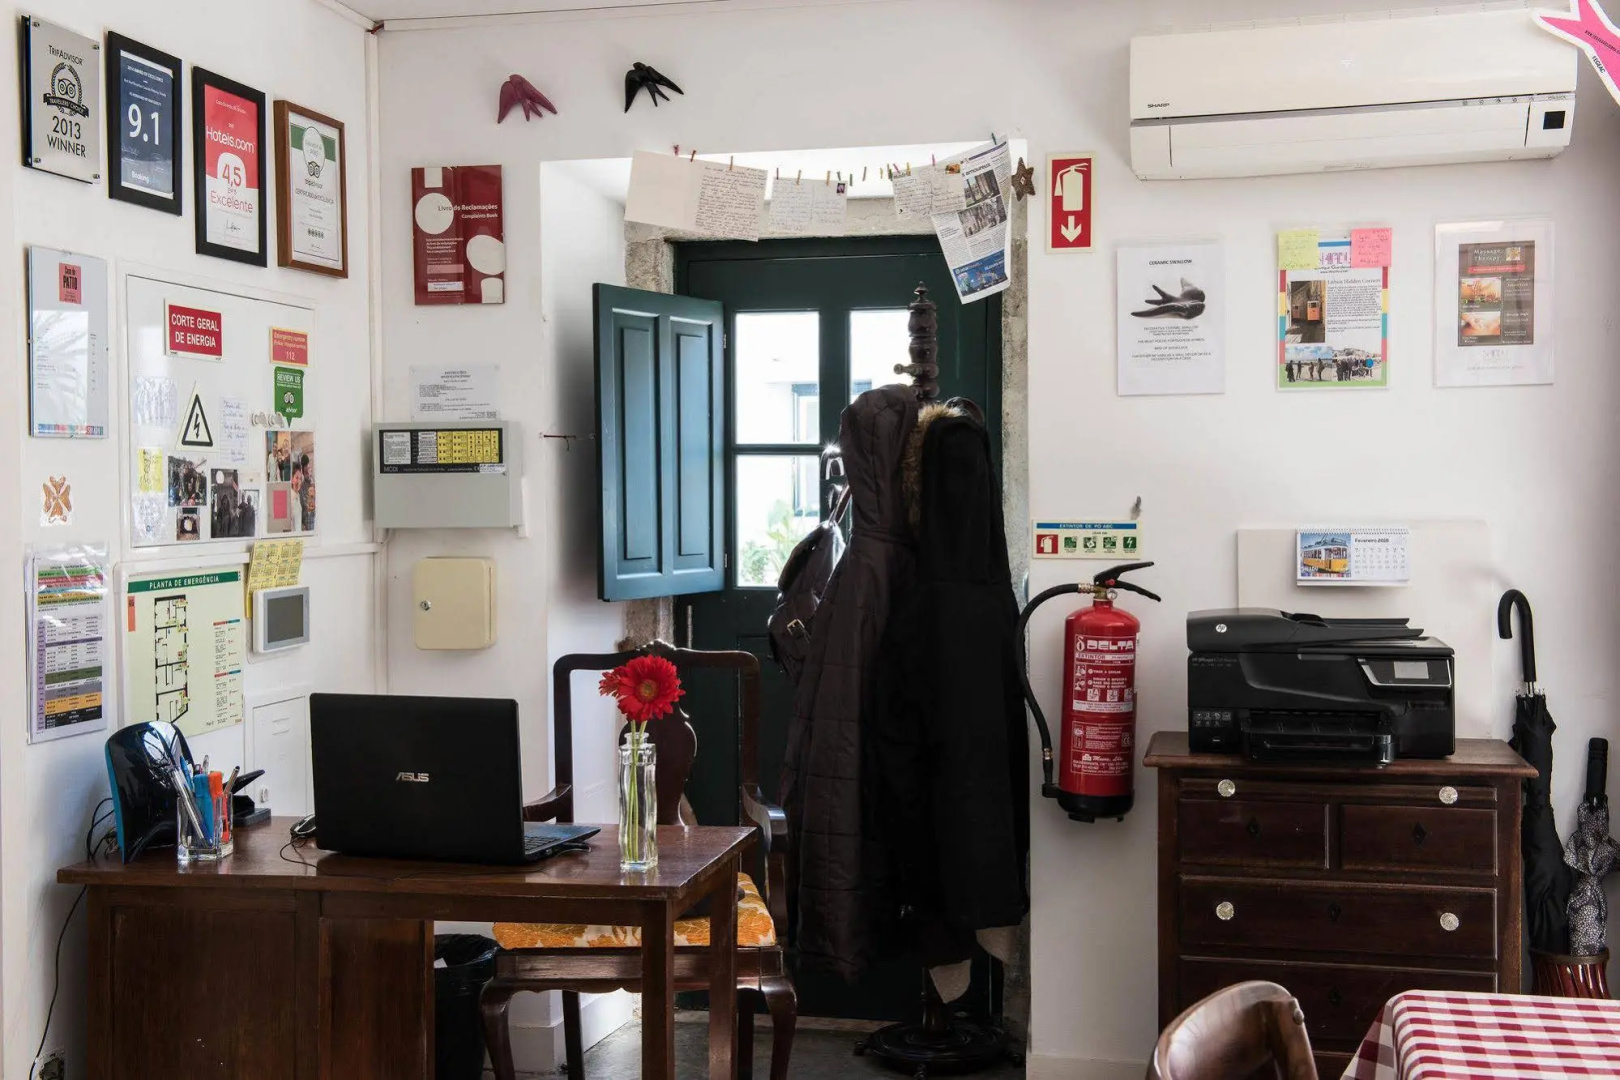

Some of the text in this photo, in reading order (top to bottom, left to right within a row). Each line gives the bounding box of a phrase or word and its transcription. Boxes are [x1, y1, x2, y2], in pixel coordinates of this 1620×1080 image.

[52, 115, 81, 140] 2013
[127, 103, 160, 146] 9.1
[46, 133, 87, 158] WINNER
[222, 163, 242, 188] 4,5
[209, 190, 254, 214] Excelente
[461, 203, 498, 212] Reclamações
[1473, 254, 1502, 262] Therapy
[171, 312, 220, 332] CORTE GERAL
[174, 331, 217, 349] DE ENERGIA
[276, 373, 301, 384] REVIEW US
[149, 574, 220, 590] PLANTA DE EMERGÊNCIA
[1086, 639, 1134, 651] DELTA
[396, 771, 430, 783] ASUS
